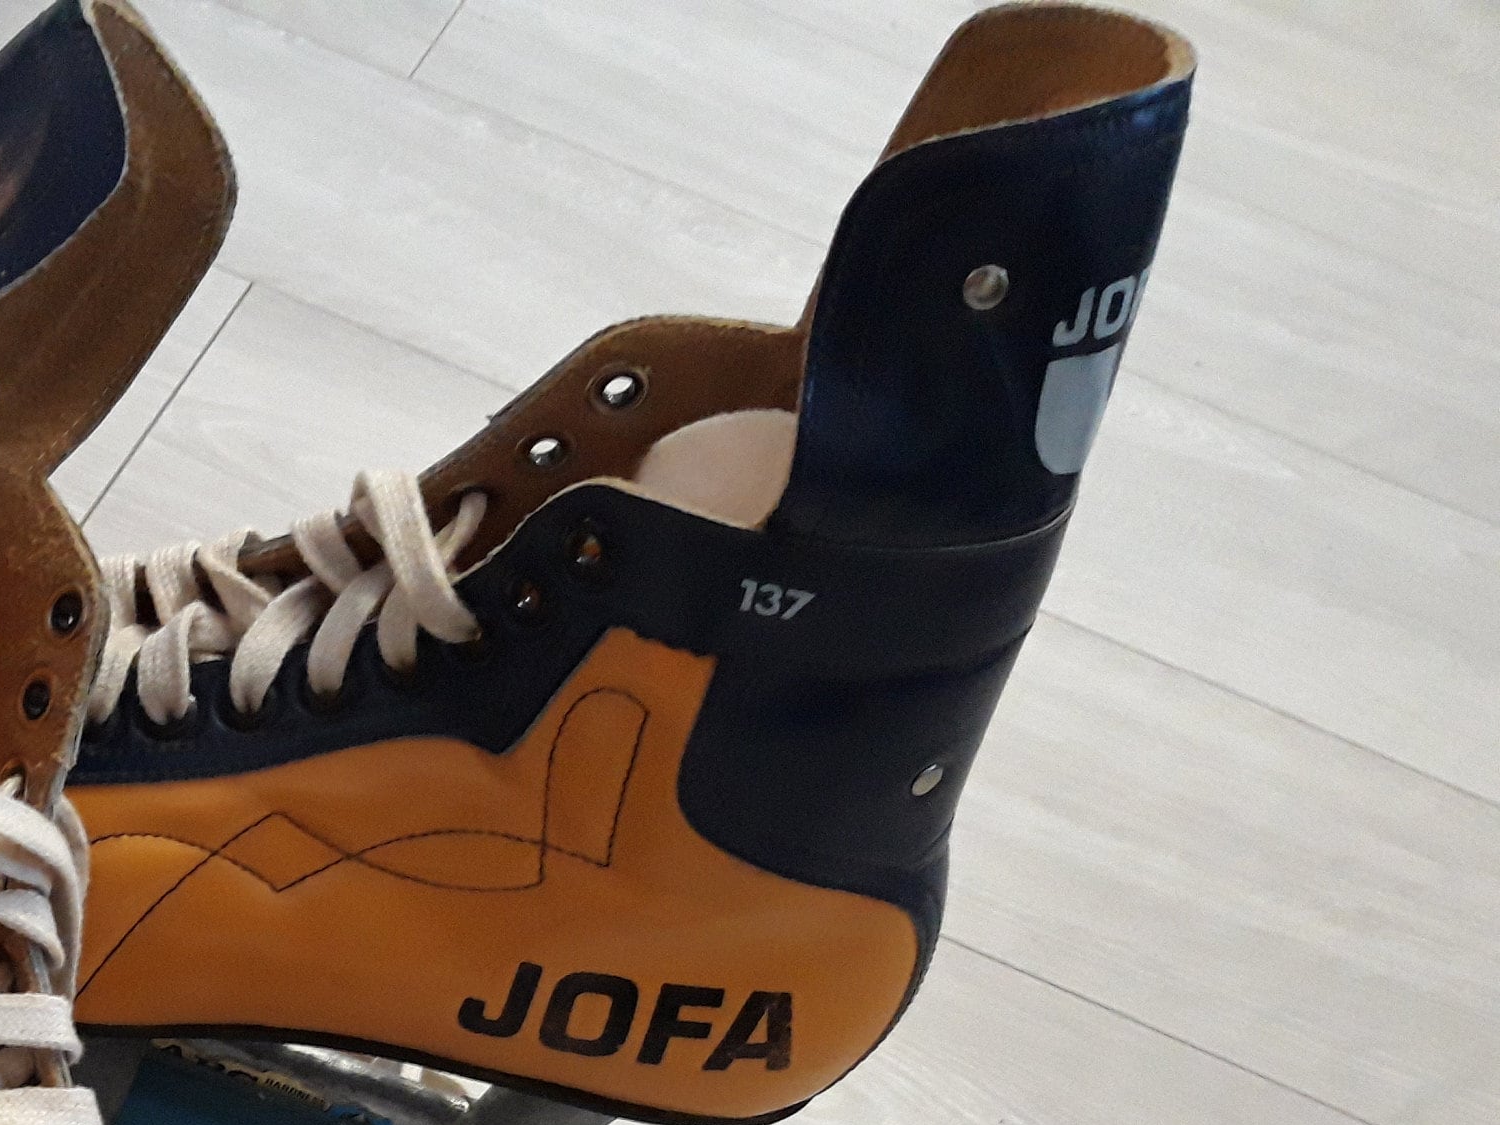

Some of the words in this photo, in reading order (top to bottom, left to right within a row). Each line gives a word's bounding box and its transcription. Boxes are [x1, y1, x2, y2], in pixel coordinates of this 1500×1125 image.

[1052, 268, 1150, 348] JO
[739, 578, 816, 620] 137
[457, 961, 792, 1071] JOFA
